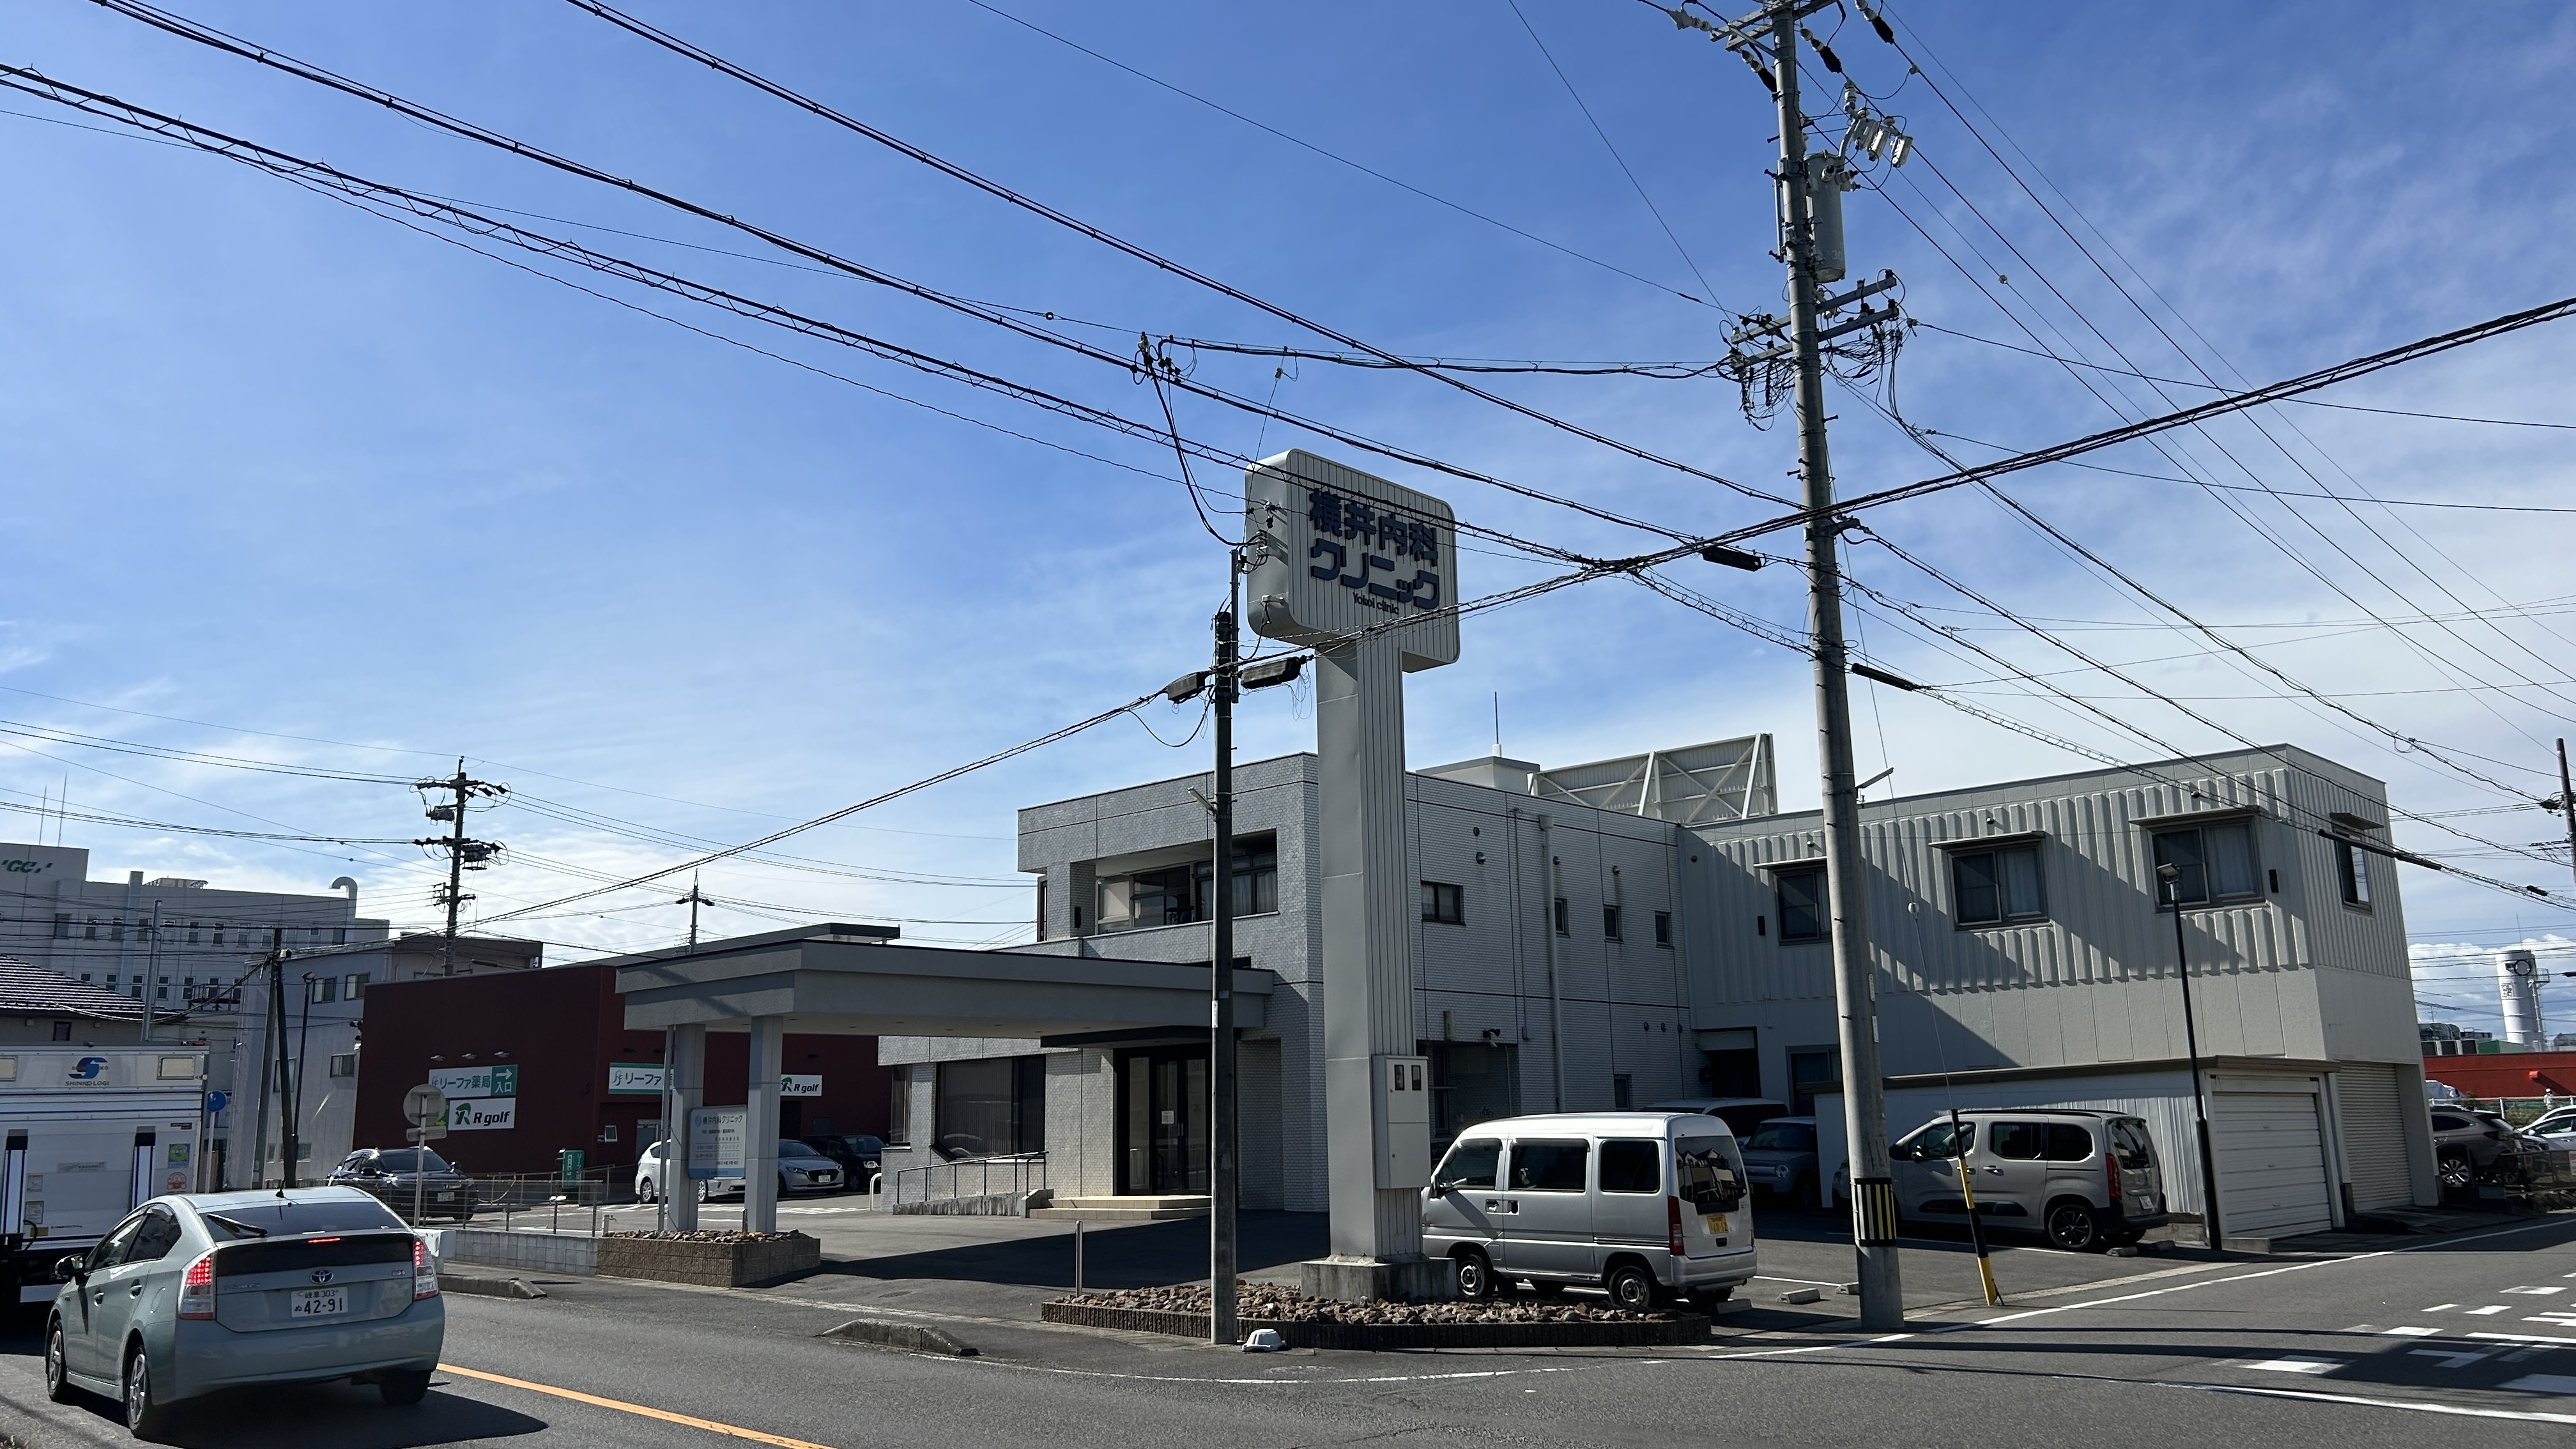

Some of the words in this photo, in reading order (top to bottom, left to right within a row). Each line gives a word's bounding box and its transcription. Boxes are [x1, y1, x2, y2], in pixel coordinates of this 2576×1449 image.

[1309, 491, 1438, 567] 横井内科
[1310, 538, 1440, 610] クリニック
[1353, 592, 1375, 609] Yokoi
[1376, 600, 1399, 615] clinic
[440, 1075, 491, 1089] リーファ薬局
[495, 1081, 512, 1093] 入口
[801, 1084, 819, 1093] golf
[473, 1112, 482, 1124] R
[484, 1111, 510, 1126] golf
[303, 1298, 342, 1314] 42-91
